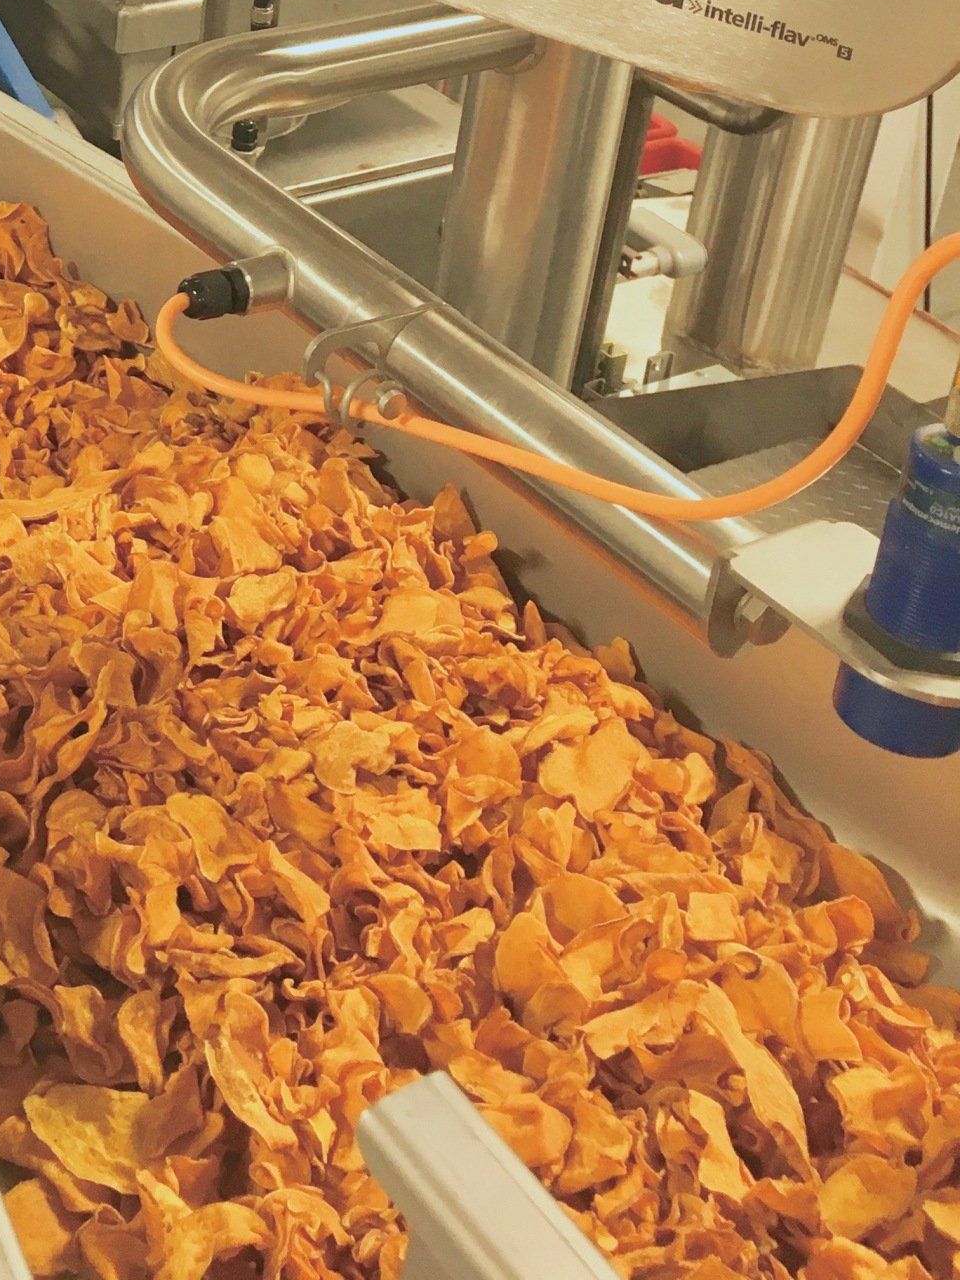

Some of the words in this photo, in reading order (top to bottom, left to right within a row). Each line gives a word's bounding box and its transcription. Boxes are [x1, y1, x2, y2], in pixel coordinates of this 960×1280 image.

[704, 0, 810, 47] intelli-flav
[816, 33, 839, 47] OMS
[838, 45, 851, 60] 5
